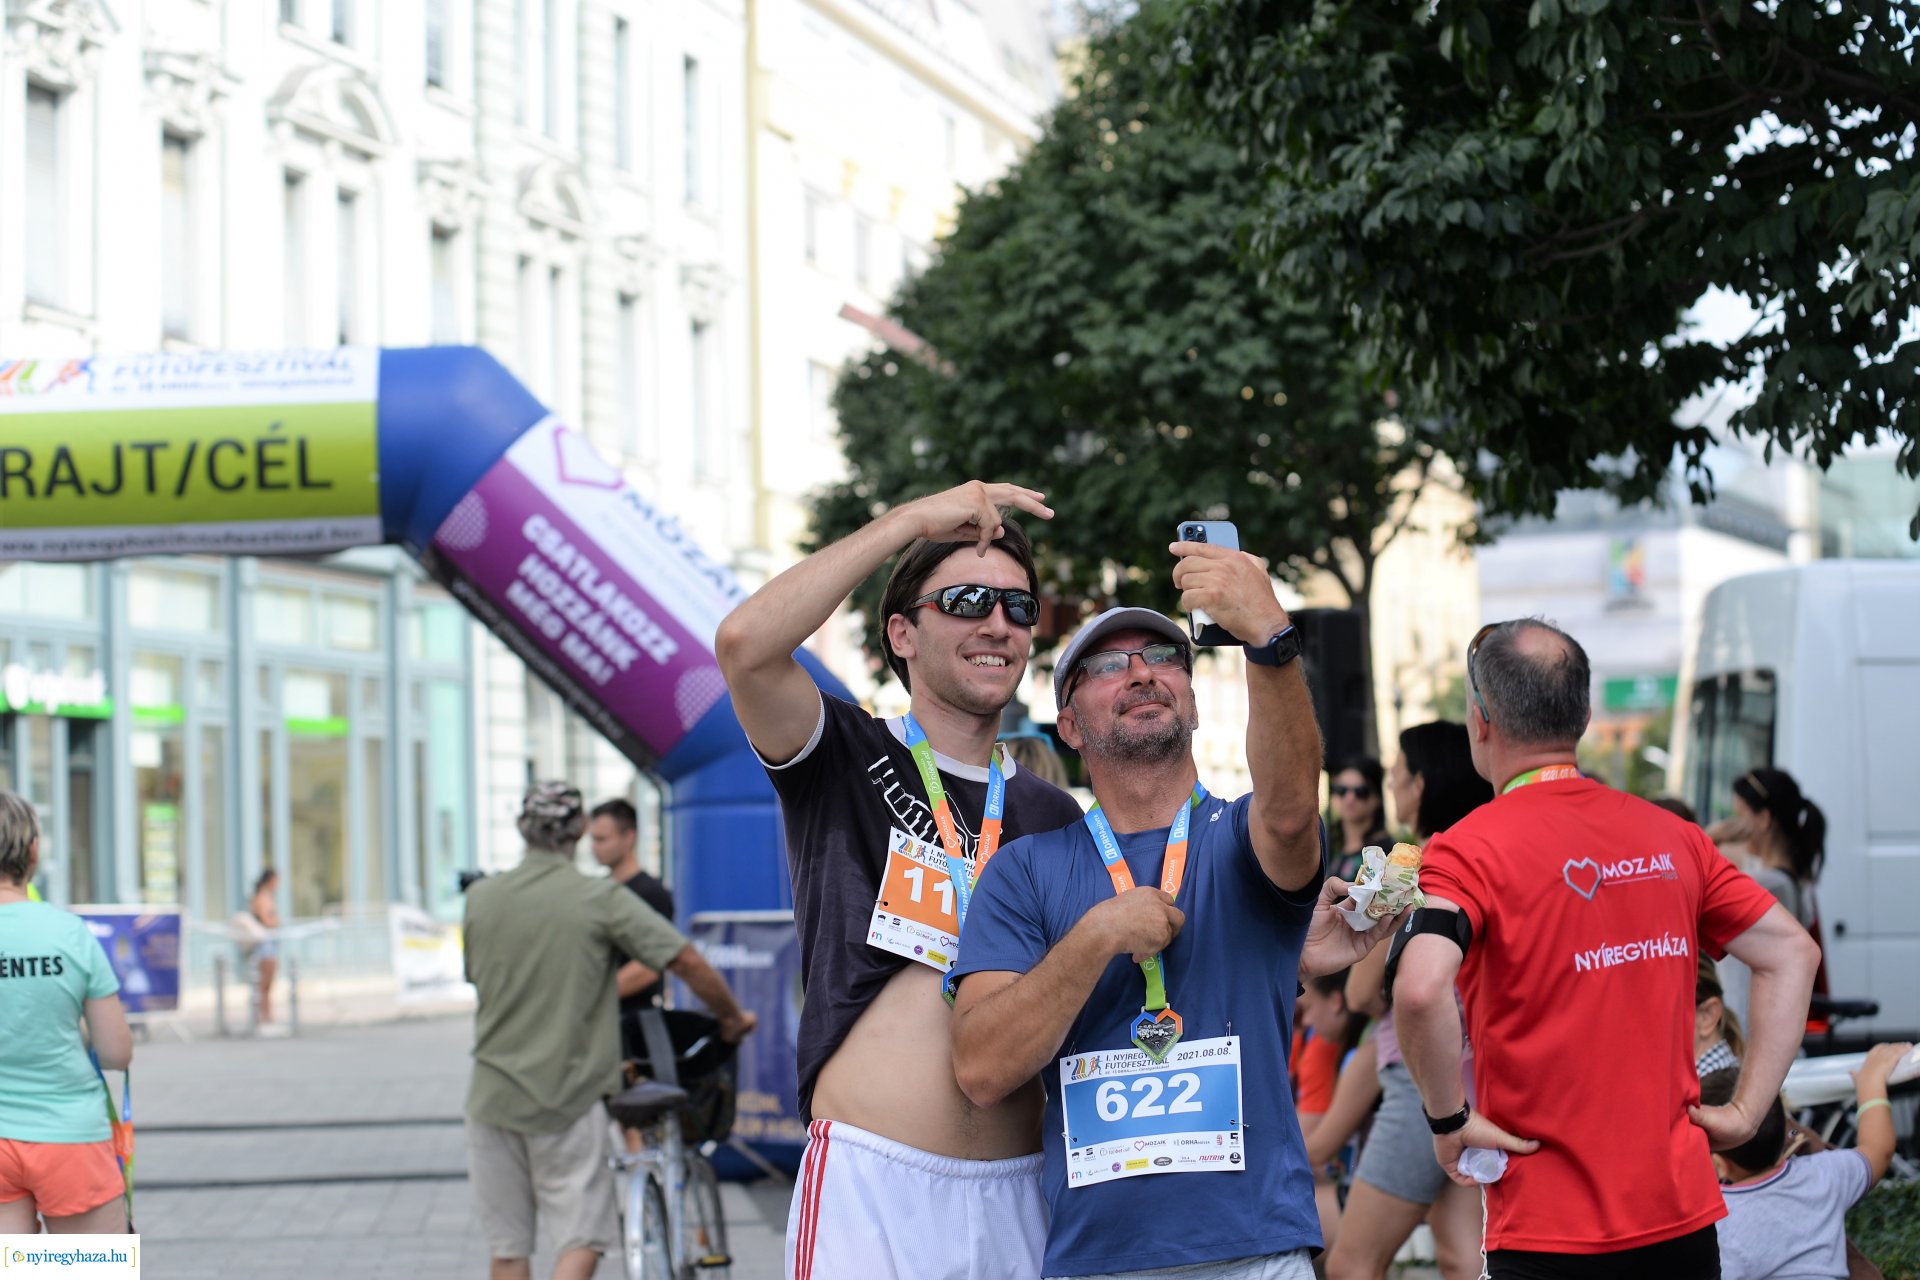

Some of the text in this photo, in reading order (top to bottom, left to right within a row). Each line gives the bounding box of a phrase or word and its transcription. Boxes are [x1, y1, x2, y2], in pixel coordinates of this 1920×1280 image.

[0, 422, 332, 498] RAJT/CÉL
[1602, 854, 1675, 879] MOZAIK
[1574, 932, 1689, 972] NYÍREGYHÁZA
[1177, 1047, 1232, 1061] 2021.08.08.
[1095, 1072, 1203, 1122] 622
